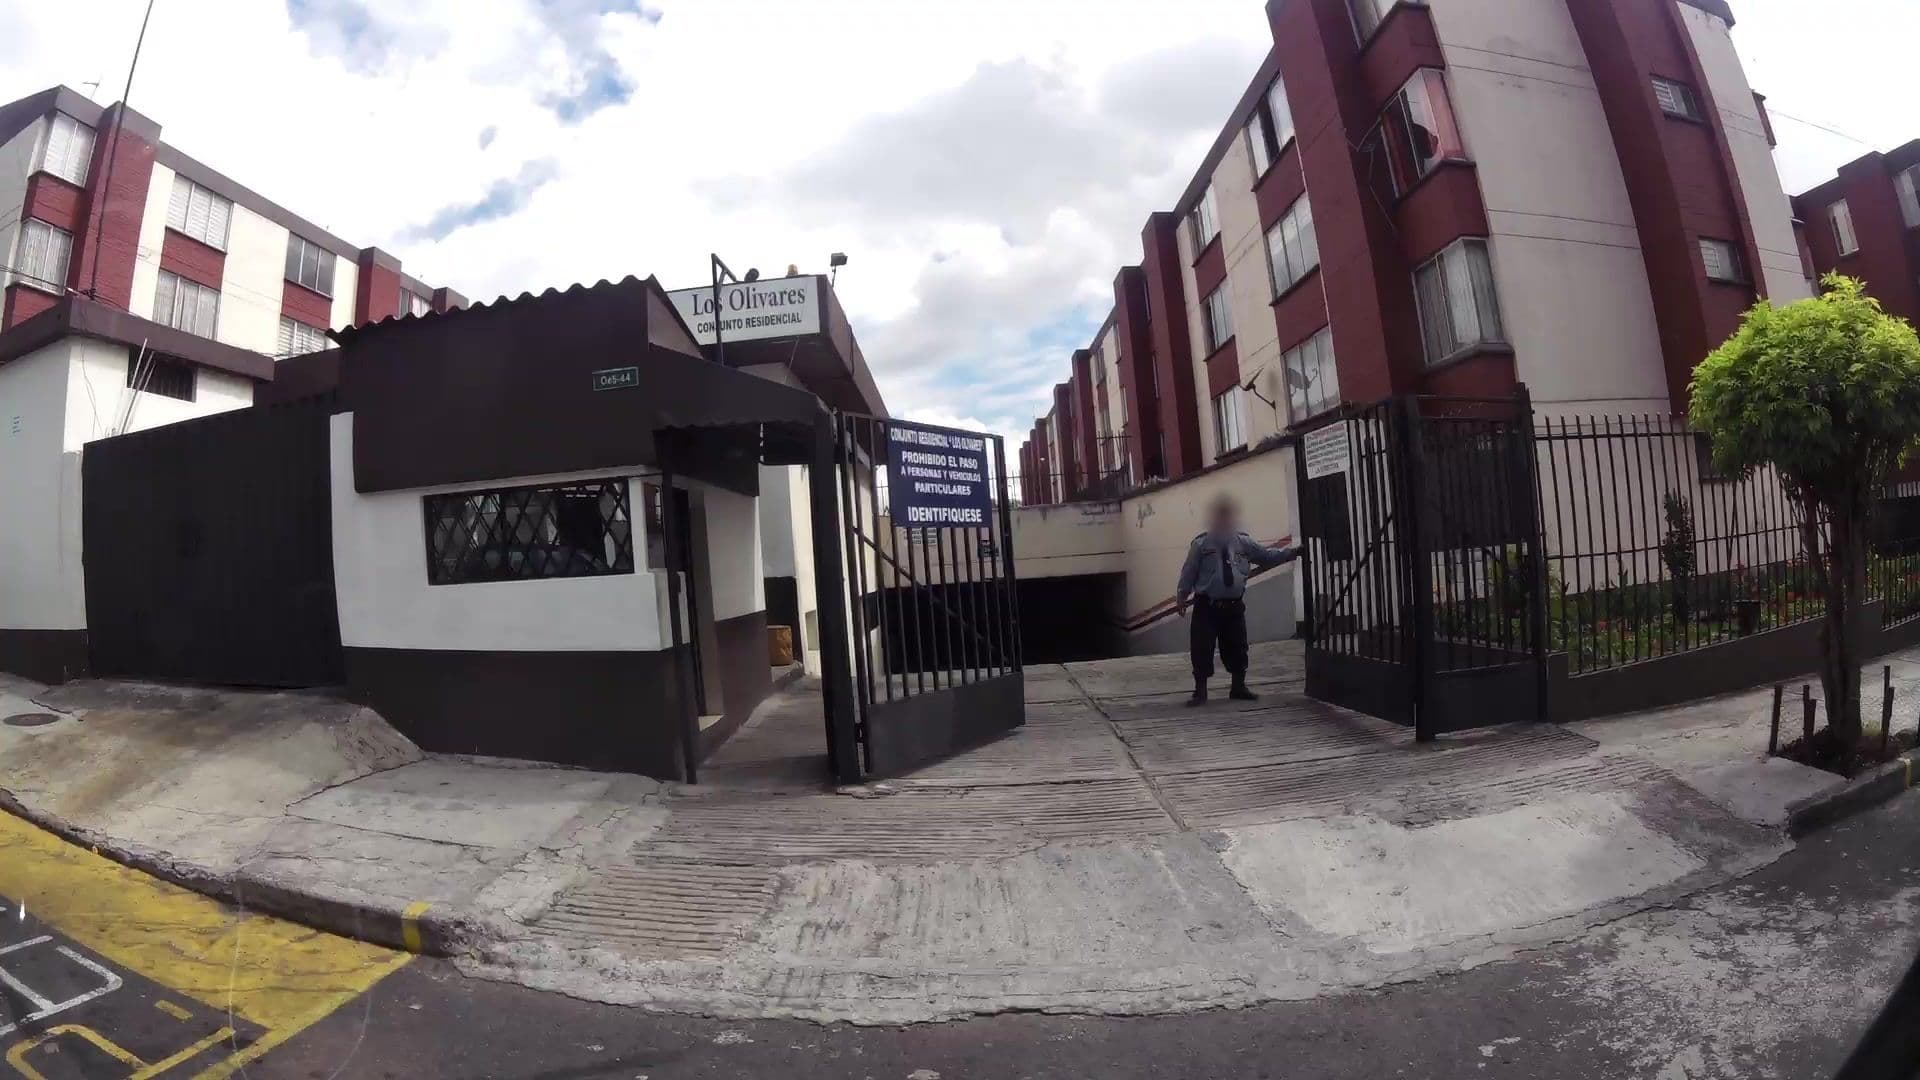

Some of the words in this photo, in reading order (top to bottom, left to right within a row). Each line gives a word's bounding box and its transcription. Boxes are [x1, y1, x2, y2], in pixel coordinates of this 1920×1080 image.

[729, 287, 805, 311] Olivares
[697, 319, 743, 333] CONUNTO
[745, 312, 802, 329] RESIDENCIAL
[902, 451, 947, 466] PROHIBIDO
[948, 456, 957, 467] EL
[959, 457, 978, 469] PASO
[901, 465, 906, 476] A
[907, 466, 942, 478] PERSONAS
[943, 470, 947, 480] Y
[949, 470, 981, 482] VEHICULOS
[915, 482, 971, 495] PARTICULARES
[908, 506, 982, 522] IDENTIFIQUESE
